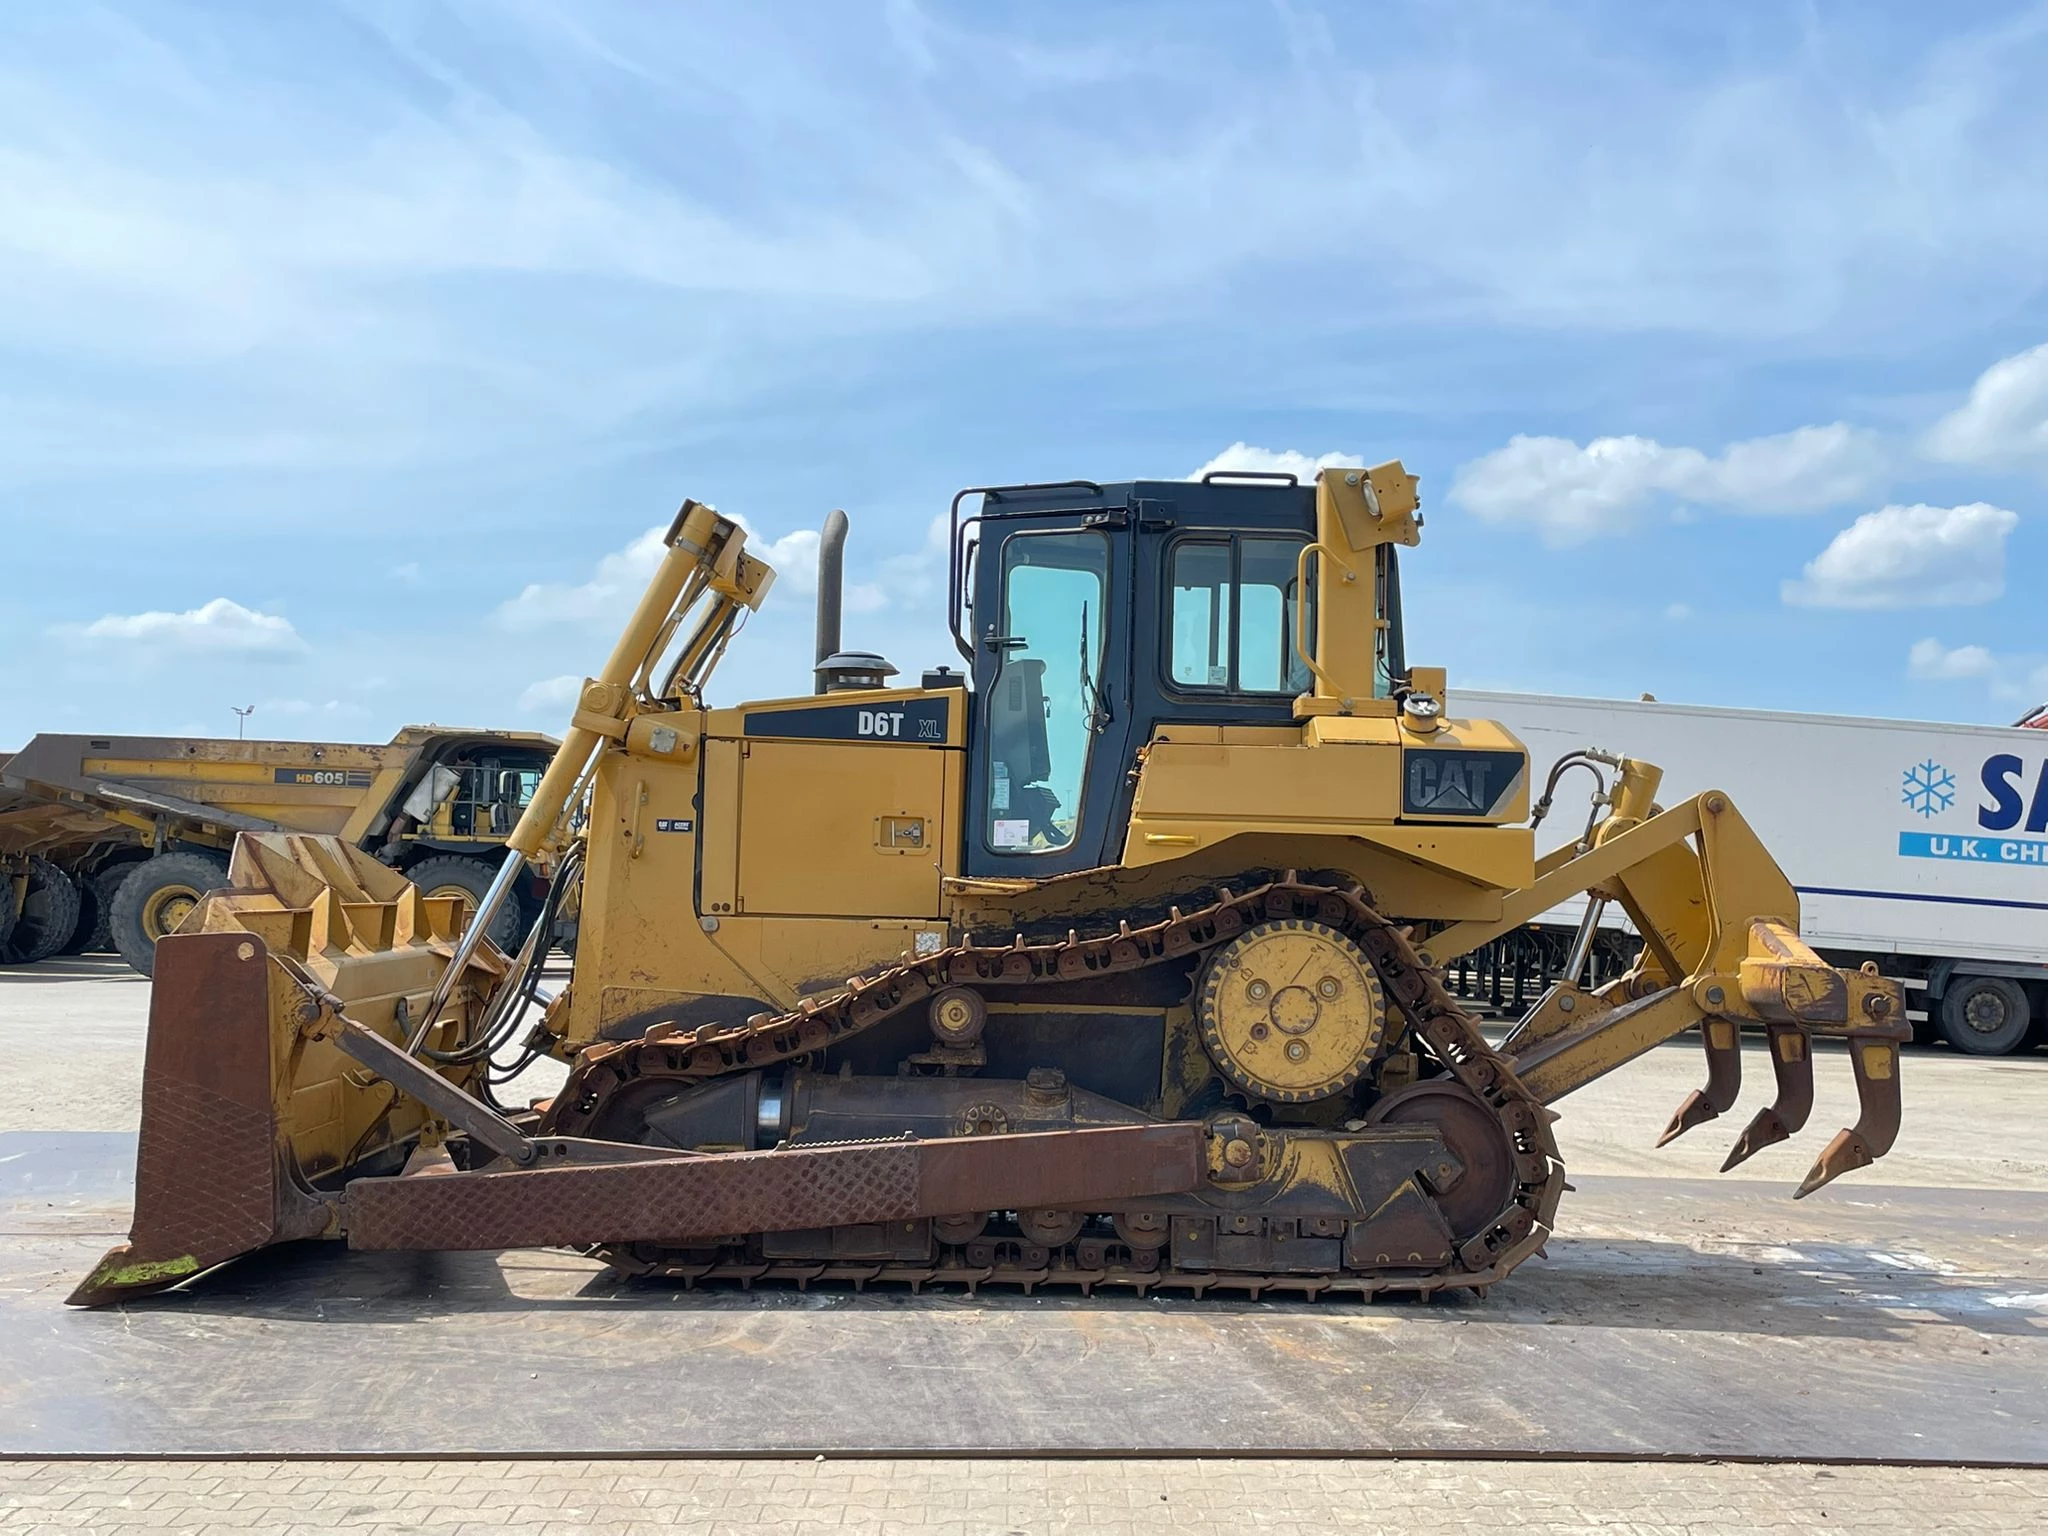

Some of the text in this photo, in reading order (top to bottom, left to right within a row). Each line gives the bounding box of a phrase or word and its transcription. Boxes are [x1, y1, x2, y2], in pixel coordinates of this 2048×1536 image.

[858, 711, 941, 738] D6T XL
[295, 771, 344, 785] HD605
[1409, 757, 1492, 810] CAT
[1930, 837, 1988, 859] U.K.
